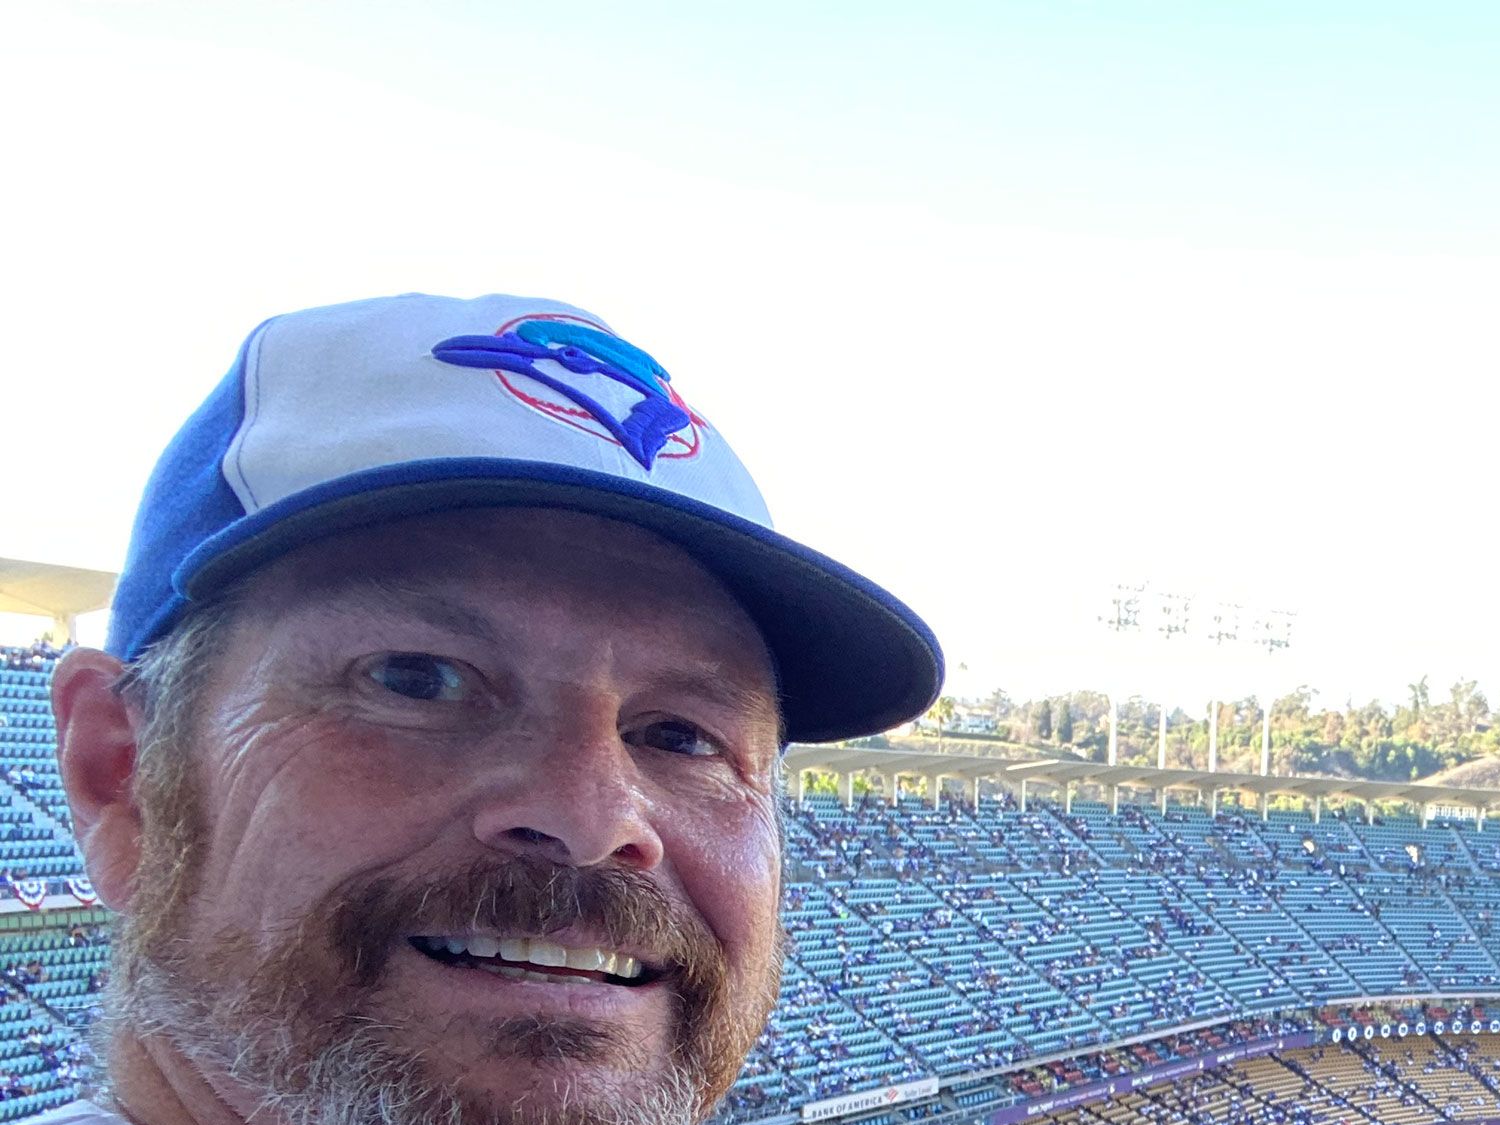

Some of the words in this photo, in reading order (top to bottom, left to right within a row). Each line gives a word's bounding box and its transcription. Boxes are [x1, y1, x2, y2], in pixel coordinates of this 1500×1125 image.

[811, 1107, 835, 1118] BANK
[836, 1104, 846, 1113] OF
[848, 1096, 883, 1110] AMERICA
